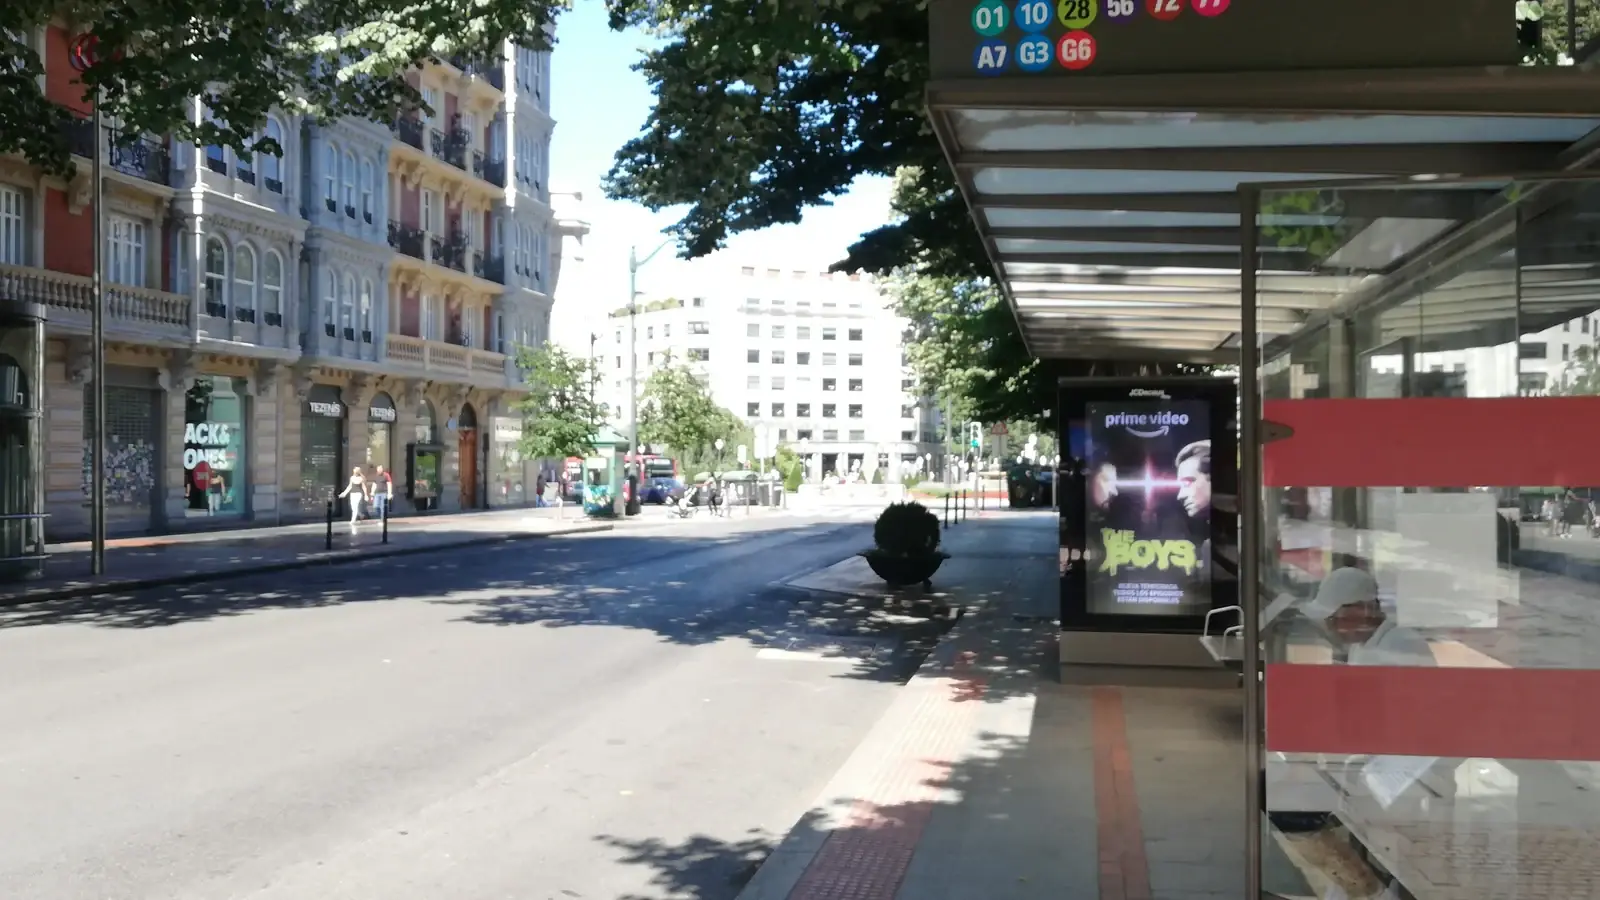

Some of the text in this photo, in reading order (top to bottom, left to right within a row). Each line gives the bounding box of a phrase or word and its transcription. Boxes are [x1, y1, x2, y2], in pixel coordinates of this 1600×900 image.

[976, 6, 1004, 29] 01
[1021, 2, 1048, 25] 10
[1064, 0, 1090, 20] 28
[1107, 0, 1134, 17] 56
[977, 38, 1091, 69] A7 G3 G6
[1105, 410, 1189, 428] prime video
[1100, 528, 1135, 544] THE
[1099, 540, 1196, 576] BOYS
